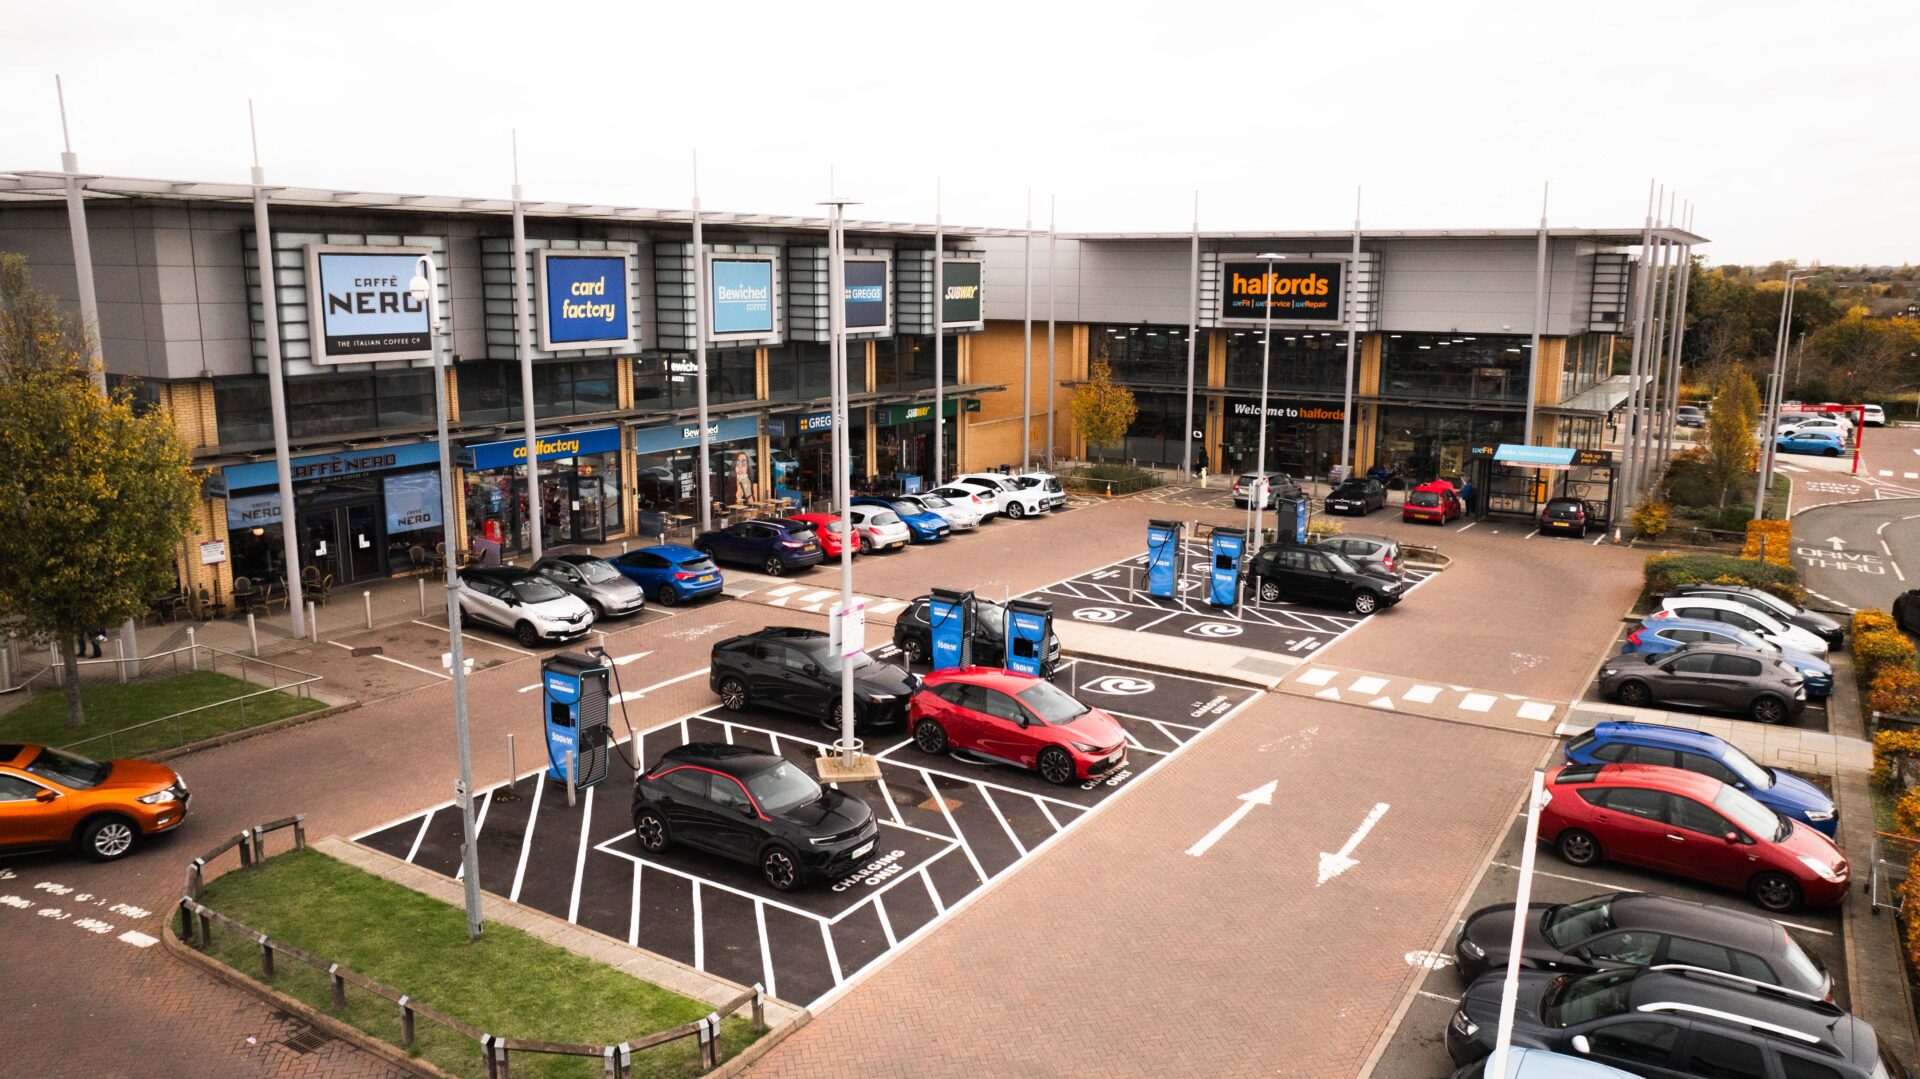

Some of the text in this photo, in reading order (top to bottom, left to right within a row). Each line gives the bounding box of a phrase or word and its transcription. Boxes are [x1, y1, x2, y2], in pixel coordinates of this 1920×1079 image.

[355, 275, 398, 287] CAFFÈ
[571, 276, 605, 296] card
[1232, 273, 1329, 295] halfords
[718, 284, 767, 299] Bewiched
[852, 288, 881, 299] GREGGS
[945, 285, 978, 300] SUBWAY
[328, 291, 423, 315] NERO
[562, 298, 615, 322] factory
[1286, 407, 1298, 417] to
[1299, 407, 1345, 420] halfords
[513, 440, 579, 458] cadfactory
[241, 507, 281, 520] NERO
[397, 513, 431, 526] NERO
[1797, 547, 1883, 564] DRIVE
[1801, 556, 1885, 574] THRU
[1106, 769, 1132, 785] ONLY
[832, 849, 905, 892] CHARGING
[865, 863, 903, 885] ONLY
